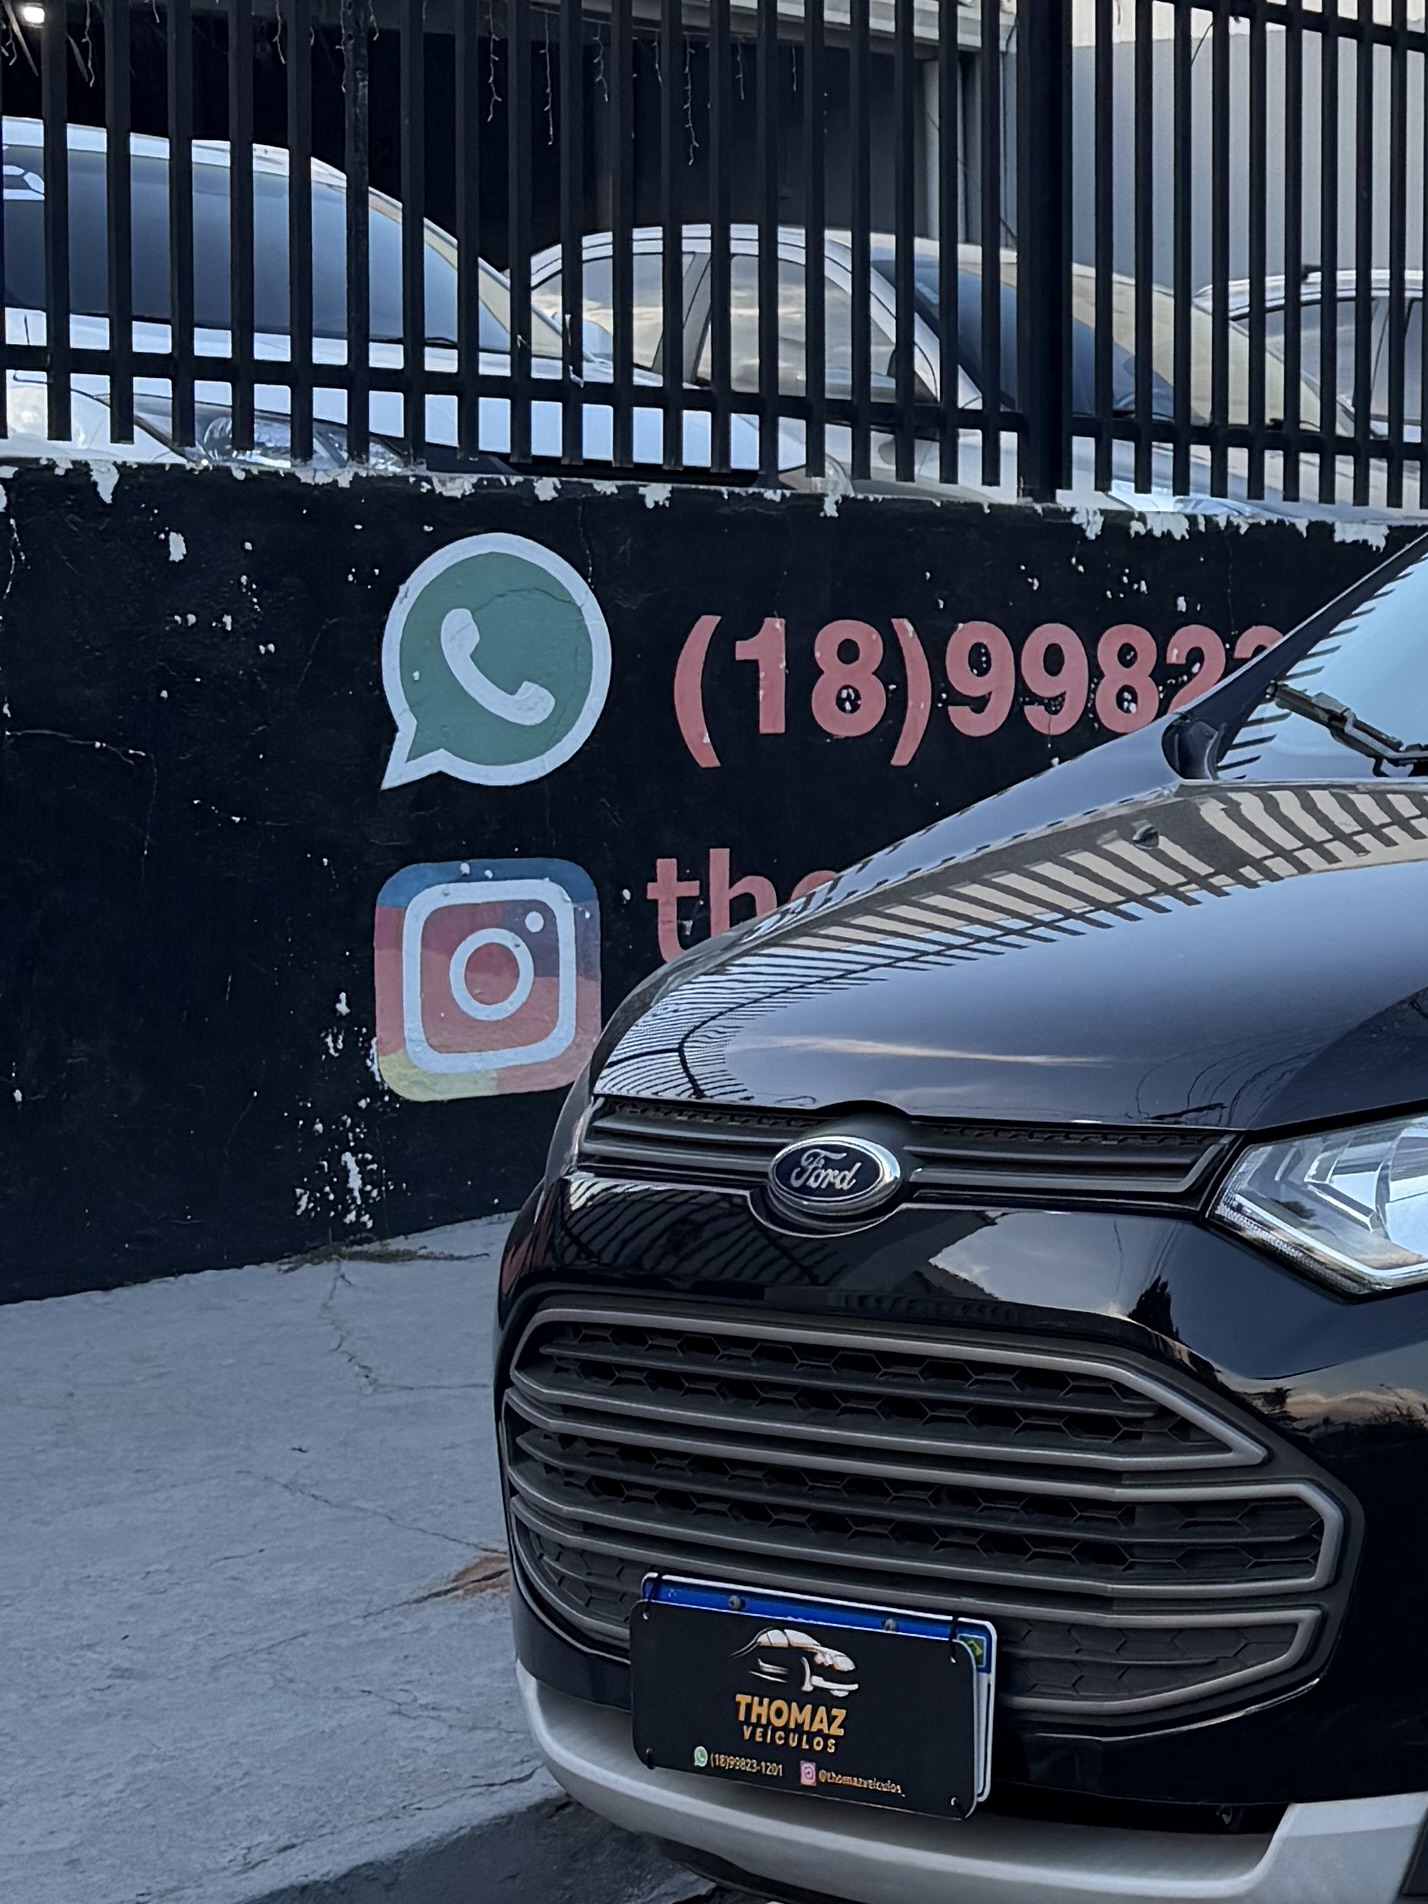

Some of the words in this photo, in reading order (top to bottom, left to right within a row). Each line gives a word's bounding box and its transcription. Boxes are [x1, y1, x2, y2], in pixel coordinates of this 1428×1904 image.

[675, 614, 1285, 768] (18)9982
[647, 848, 839, 963] th
[790, 1149, 862, 1190] Ford
[735, 1694, 847, 1736] THOMAZ
[743, 1725, 837, 1753] VEÍCULOS
